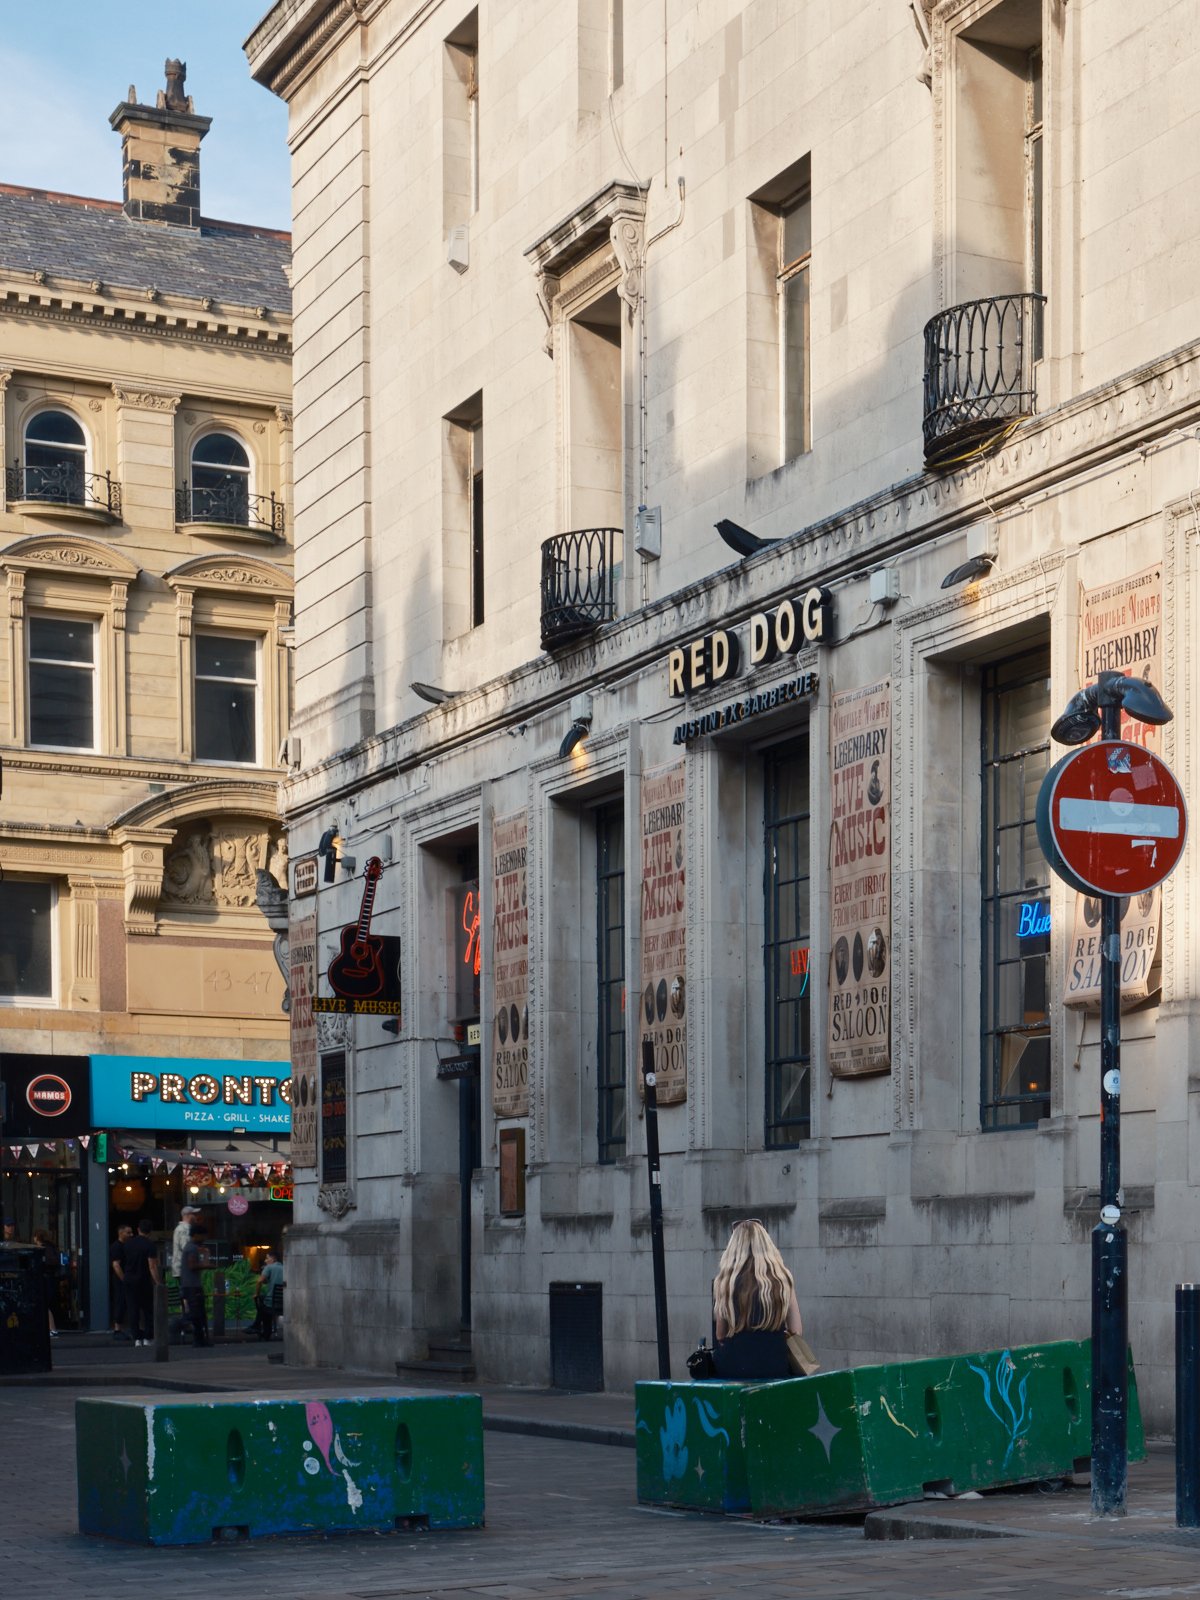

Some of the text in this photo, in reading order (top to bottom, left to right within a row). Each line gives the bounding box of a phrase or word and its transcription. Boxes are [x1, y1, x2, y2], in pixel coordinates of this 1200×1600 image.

[1091, 574, 1153, 605] RED DOG LIVE PRESENTS
[1085, 593, 1160, 640] NASHVILLE NIGHTS
[669, 587, 832, 698] RED DOG
[1085, 625, 1159, 678] LEGENDARY
[743, 672, 815, 718] BARBECUE
[834, 728, 888, 769] LEGENDARY
[834, 763, 864, 820] LIVE
[643, 832, 672, 878] LIVE
[834, 807, 886, 868] MUSIC
[496, 848, 527, 876] LEGENDAR
[495, 873, 519, 914] LIVE
[643, 870, 686, 921] MUSIC
[834, 882, 853, 904] EVERY
[1125, 926, 1155, 950] DOG
[204, 969, 272, 994] 43-47
[1070, 948, 1153, 991] SALON
[312, 997, 400, 1015] LIVE MUSIC
[834, 986, 887, 1011] RED DOG
[832, 1004, 887, 1042] SALOON
[496, 1062, 528, 1089] SALOO
[654, 1043, 686, 1073] LOON
[33, 1091, 66, 1100] MAMOS
[184, 1112, 290, 1124] PIZZA GRILL SHAKE
